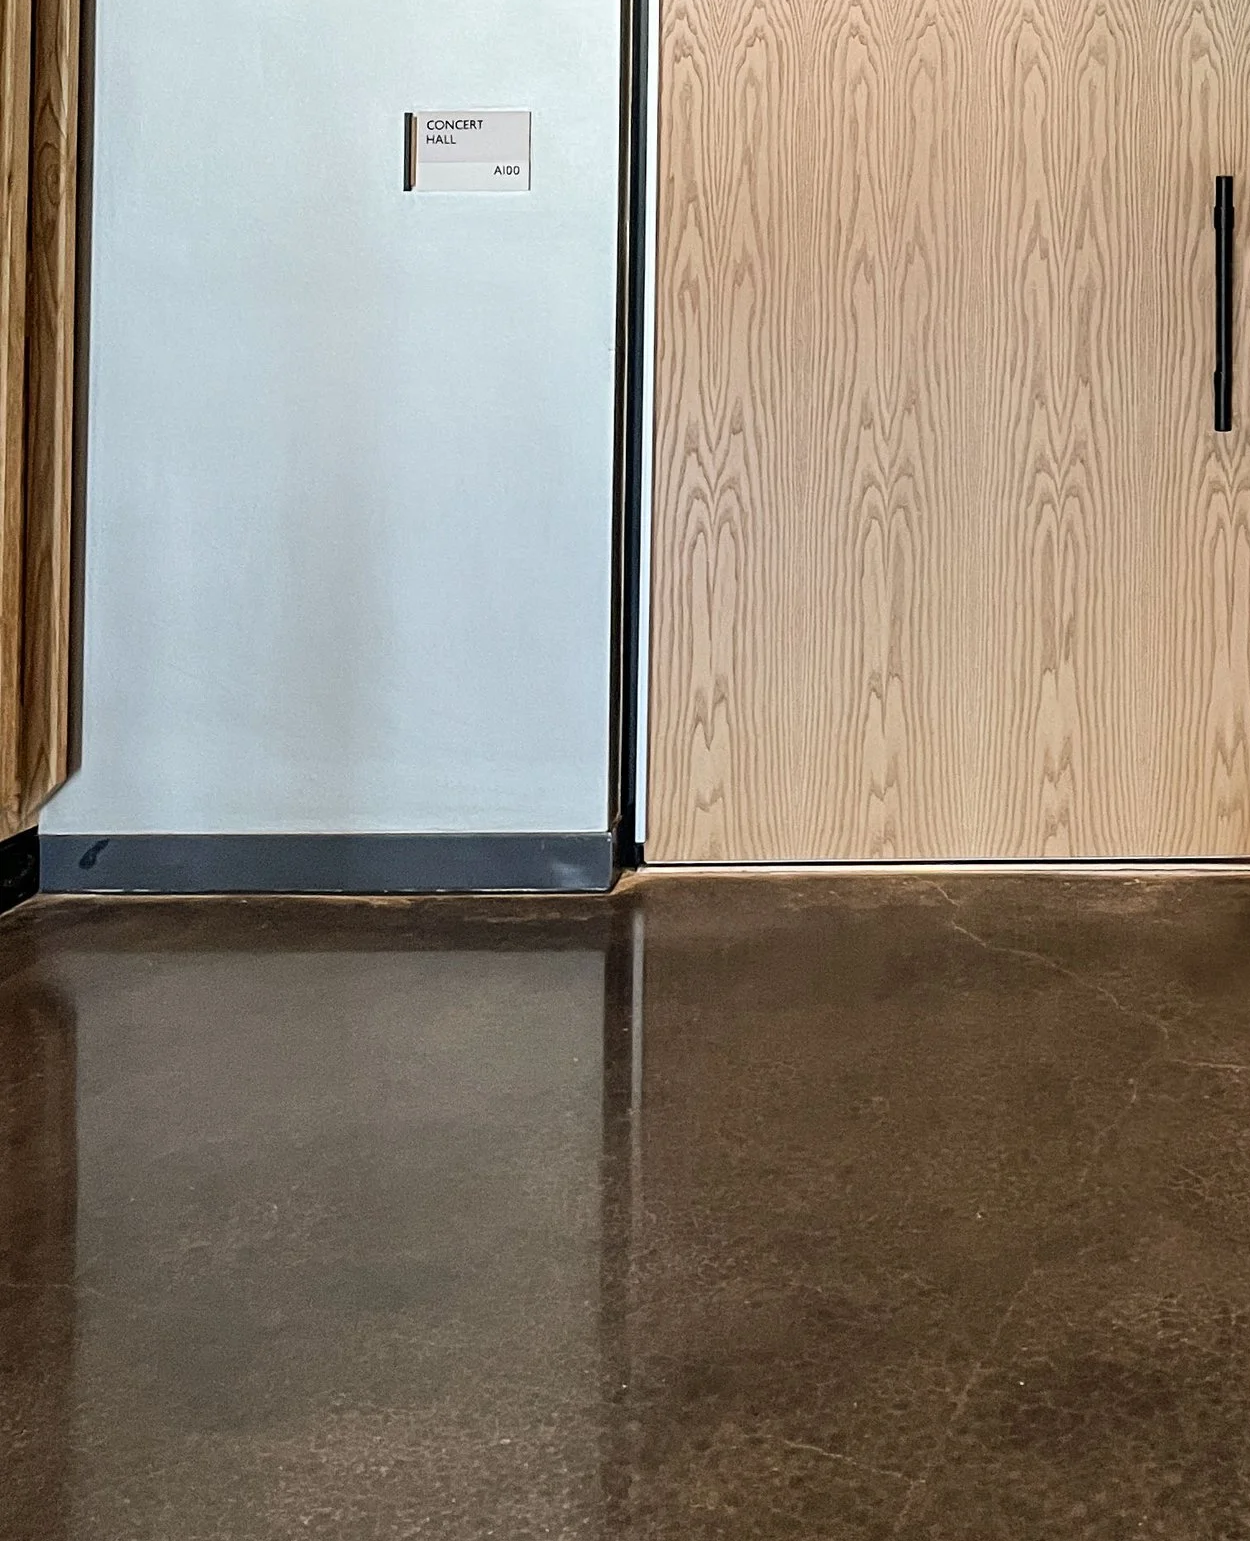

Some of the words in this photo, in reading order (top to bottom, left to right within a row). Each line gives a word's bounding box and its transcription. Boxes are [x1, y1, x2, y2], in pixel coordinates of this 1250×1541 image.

[426, 119, 484, 131] CONCERT
[426, 134, 457, 145] HALL
[493, 165, 521, 176] A100
